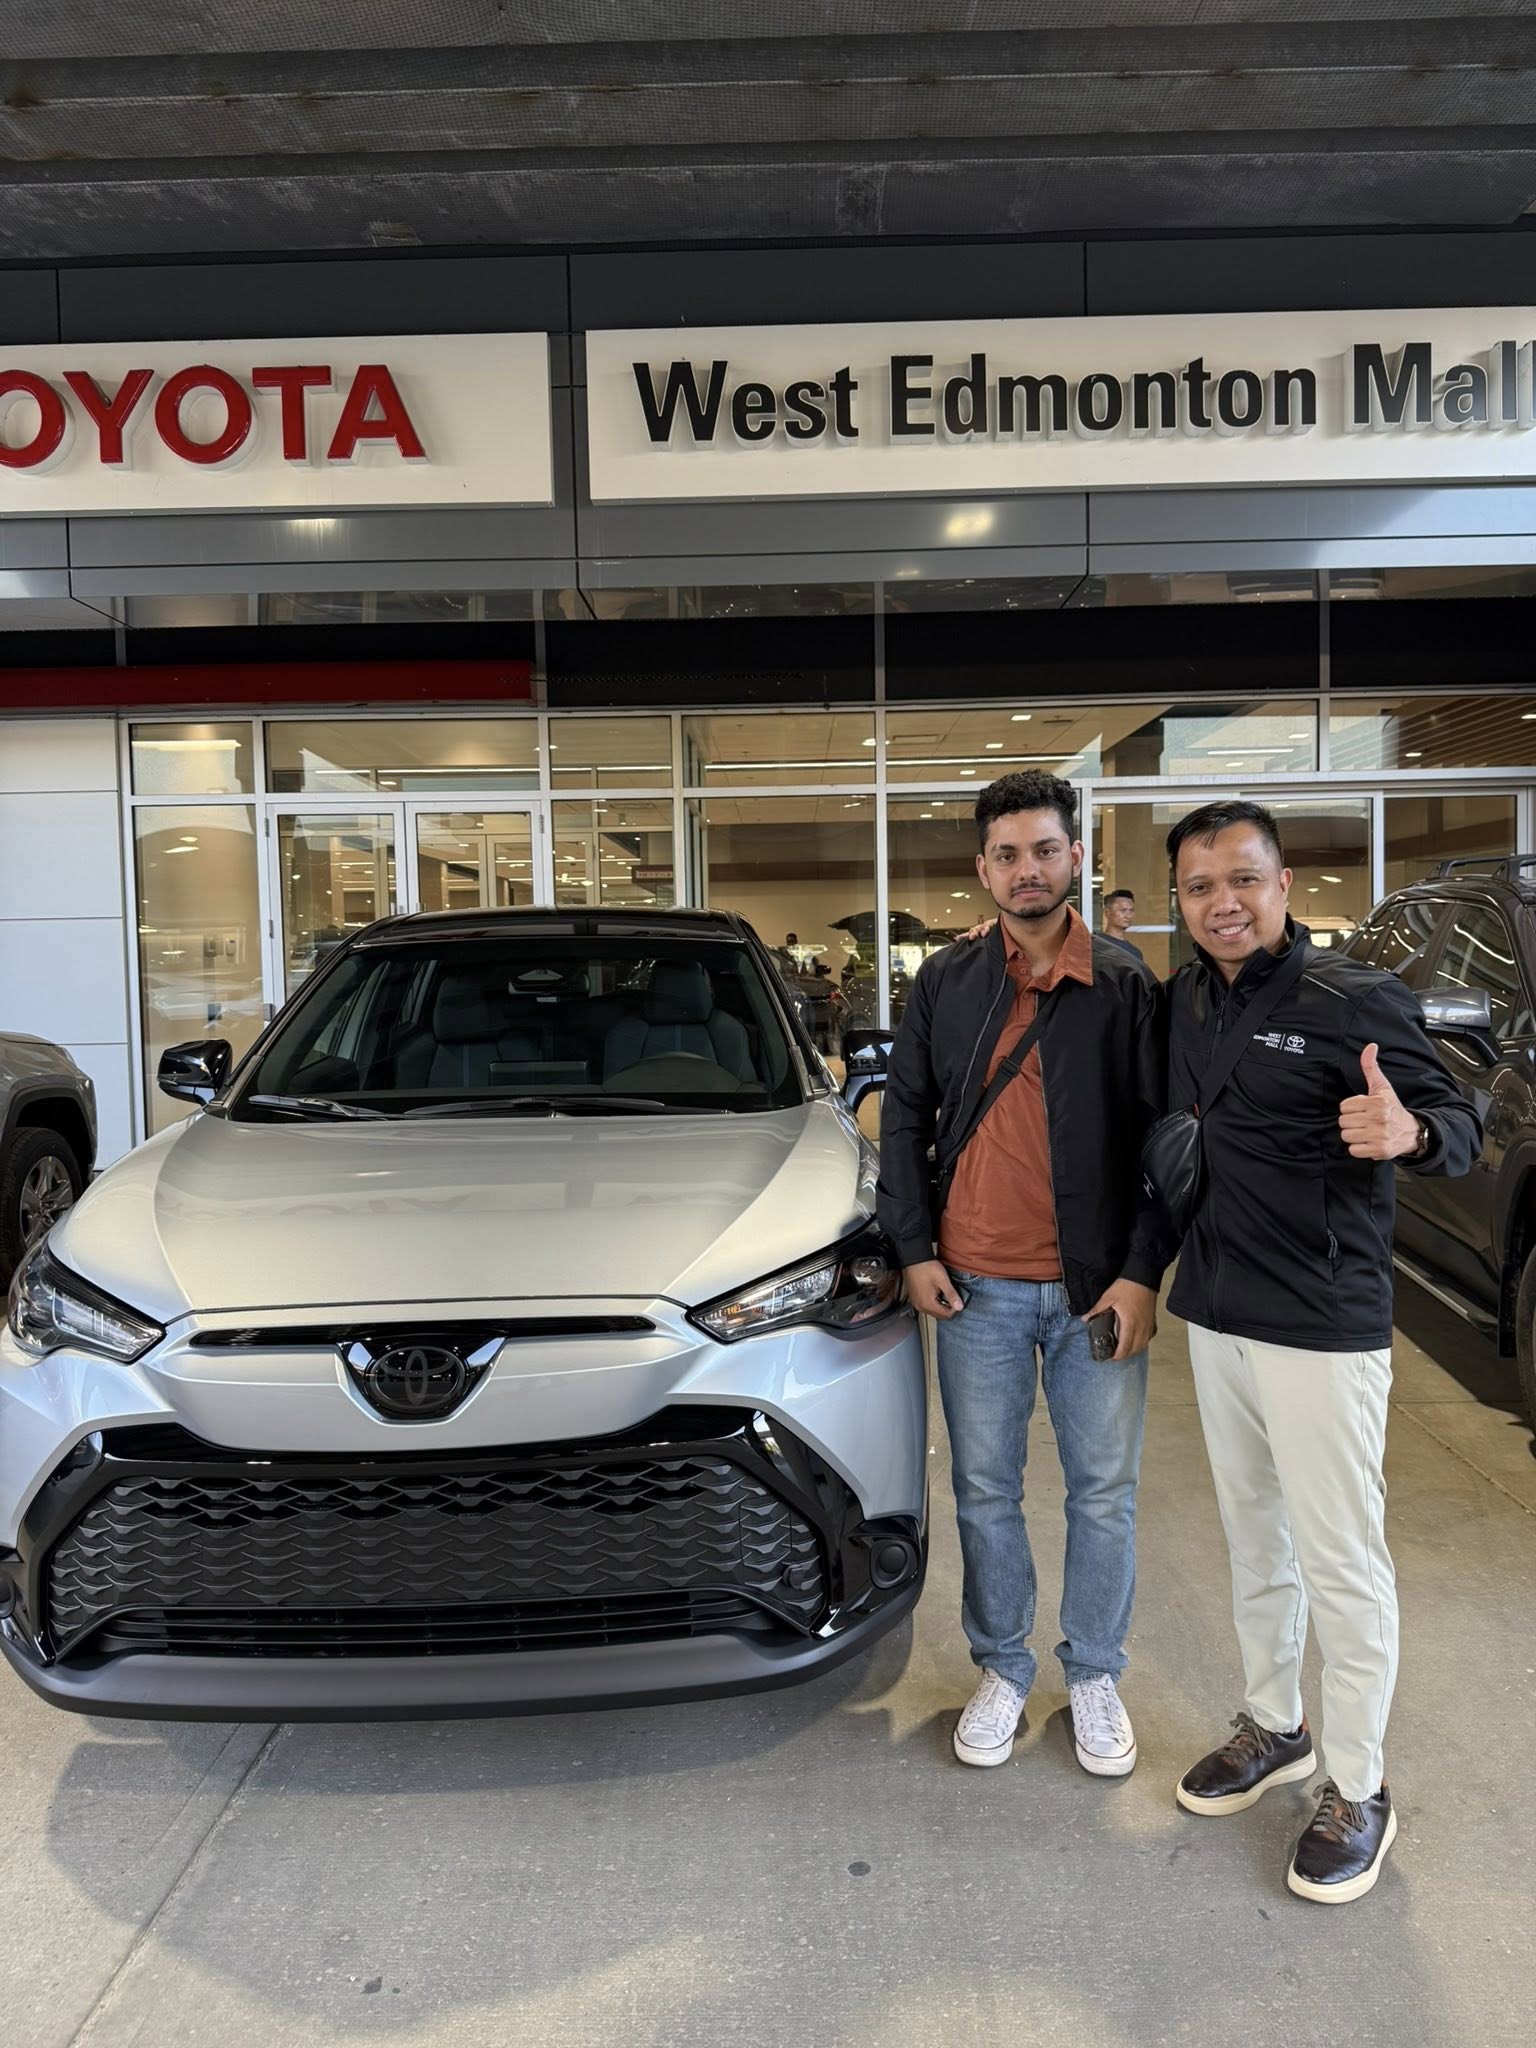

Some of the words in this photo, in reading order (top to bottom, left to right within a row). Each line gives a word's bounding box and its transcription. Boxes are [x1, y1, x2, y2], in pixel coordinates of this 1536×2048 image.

[632, 360, 859, 443] West
[890, 353, 1317, 438] Edmonton
[1353, 339, 1536, 425] Mal
[1253, 1034, 1281, 1043] EDMONTON
[1283, 1046, 1304, 1054] TOYOTA
